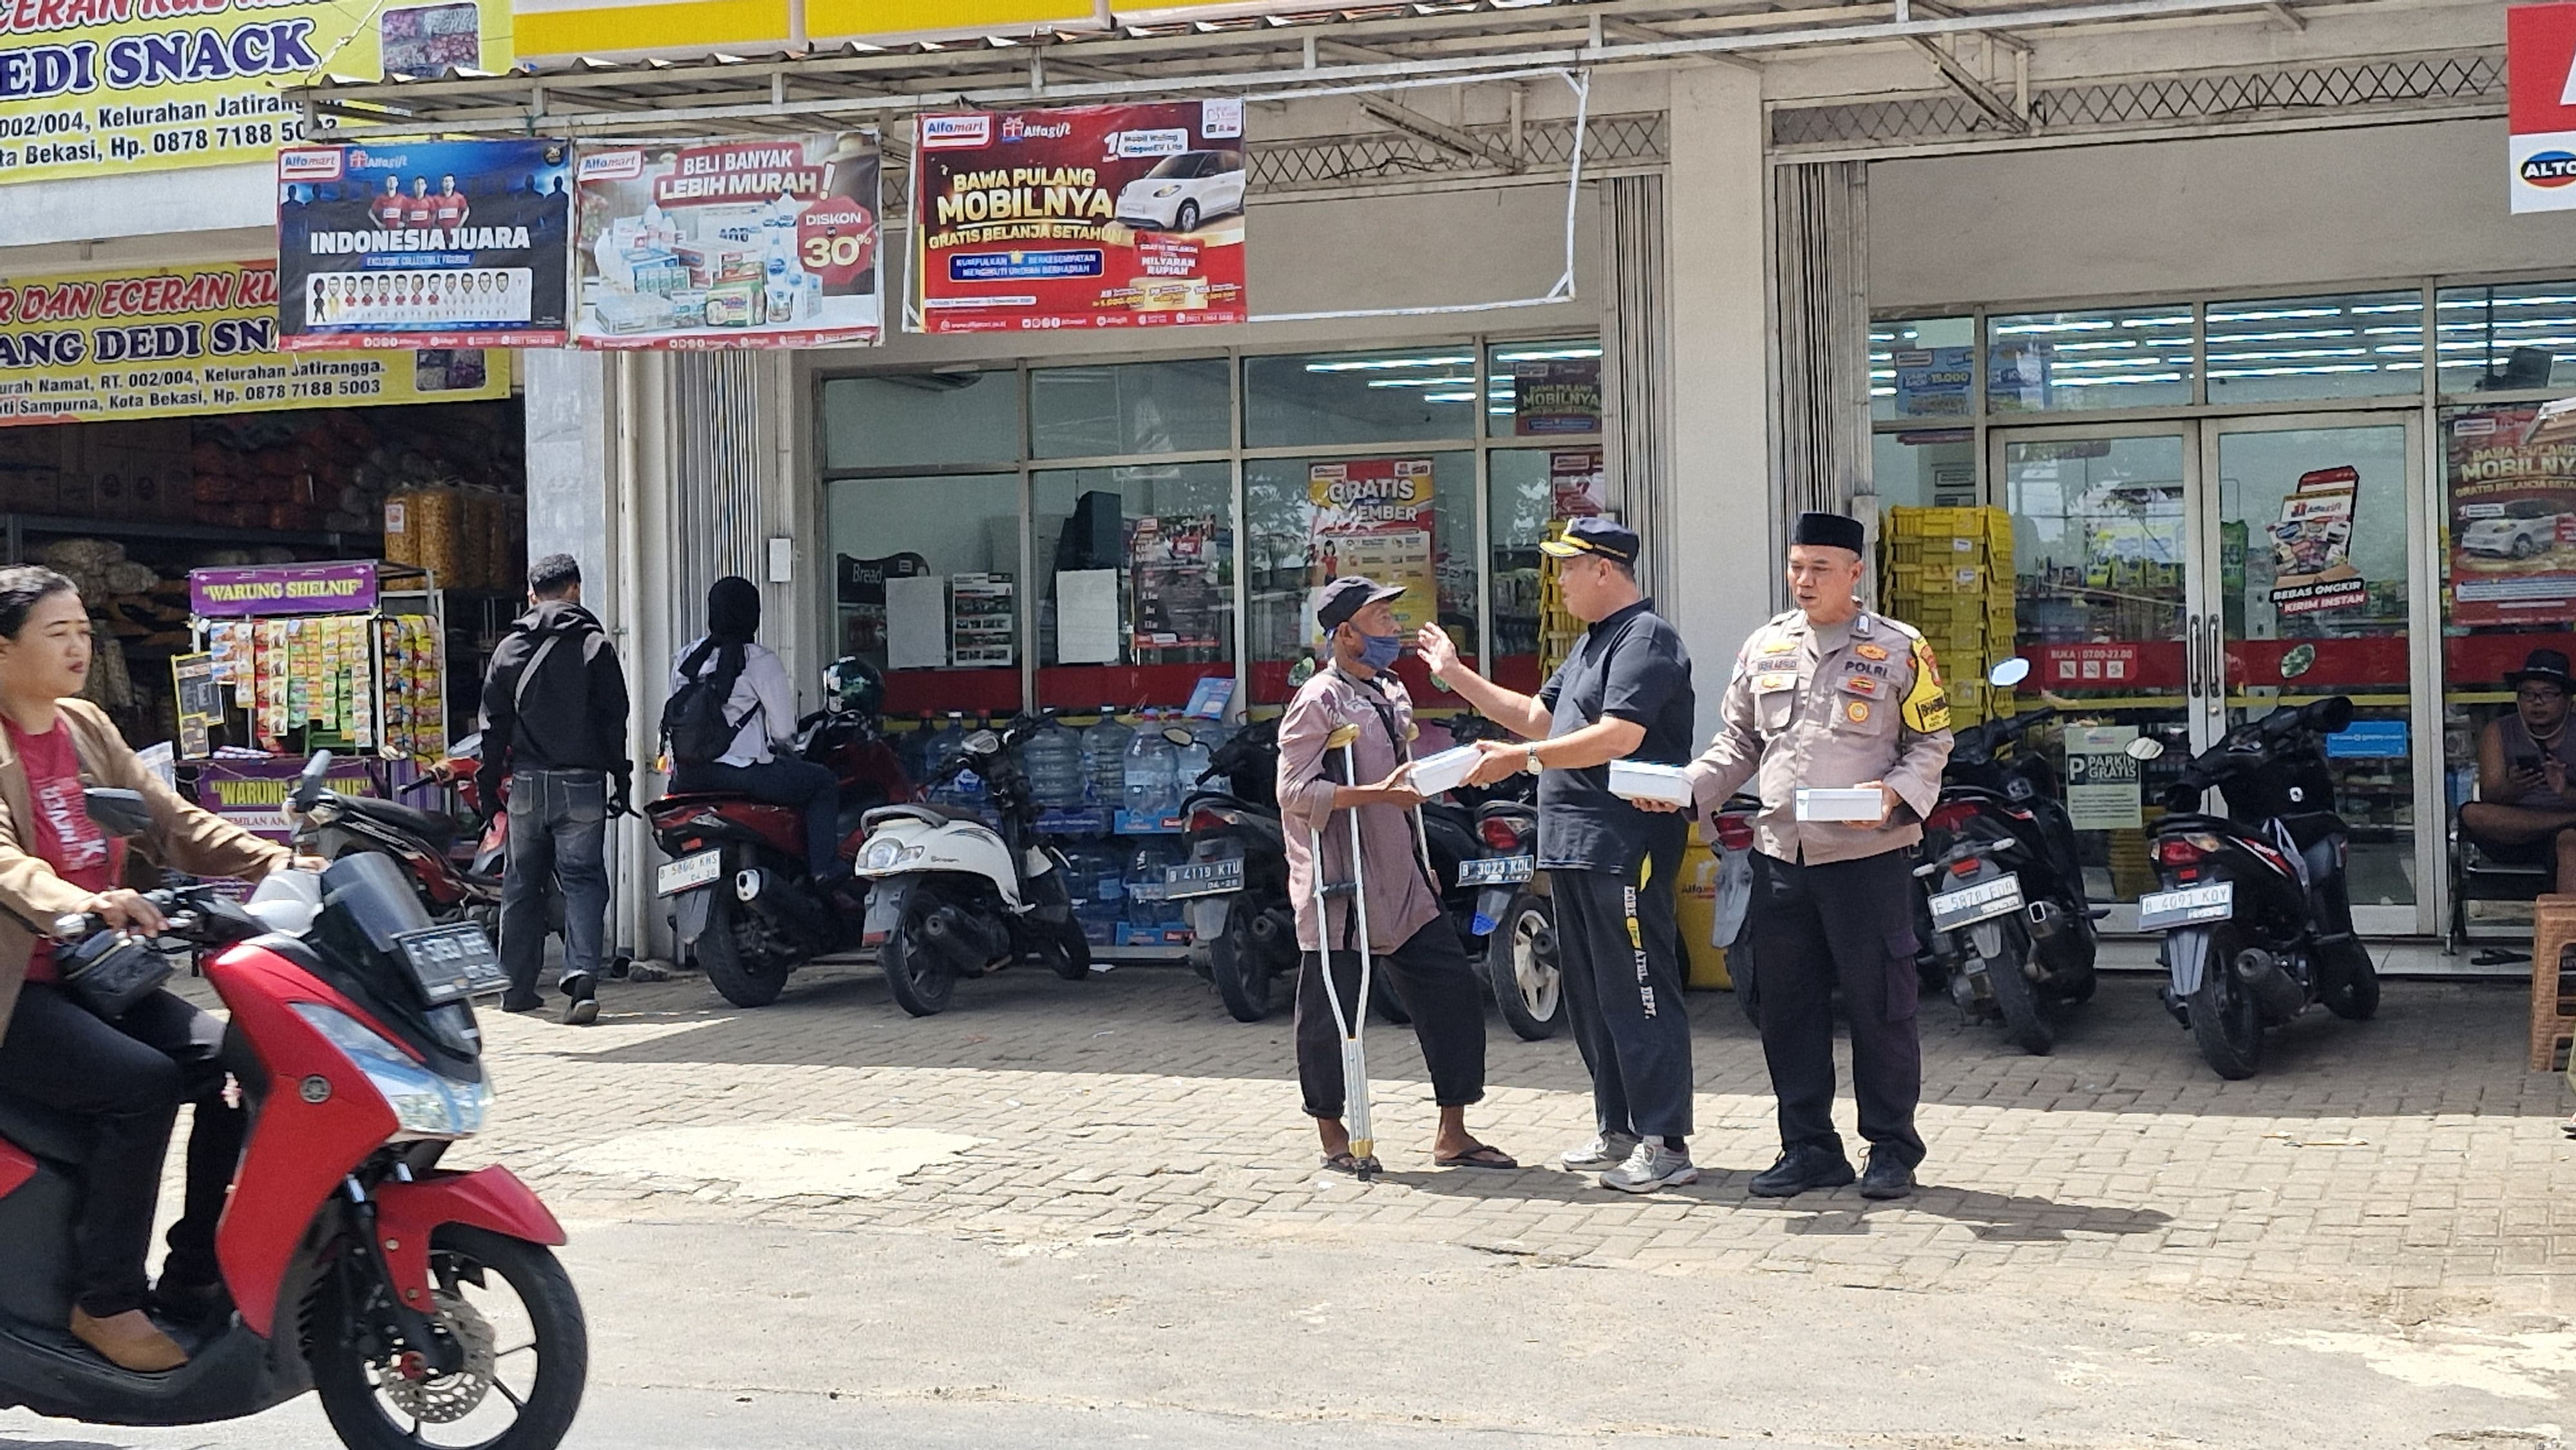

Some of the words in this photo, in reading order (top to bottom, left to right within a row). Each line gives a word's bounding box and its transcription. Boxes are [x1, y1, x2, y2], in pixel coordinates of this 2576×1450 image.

[110, 23, 314, 84] SNACK
[99, 102, 206, 128] Kelurahan
[927, 120, 984, 133] Alfamart
[1023, 122, 1071, 138] Alfagift
[26, 139, 102, 163] Bekasi,
[111, 136, 145, 160] Hp.
[154, 129, 207, 153] 0878
[217, 124, 272, 147] 7188
[285, 155, 336, 167] Alfamart
[583, 156, 636, 171] Alfamart
[683, 155, 719, 175] BELI
[724, 150, 793, 171] BANYAK
[661, 178, 724, 200] LEBIH
[954, 169, 1012, 192] BAWA
[1017, 167, 1095, 187] PULANG
[938, 189, 1113, 225] MOBILNYA
[806, 212, 861, 226] DISKON
[310, 229, 445, 254] INDONESIA
[450, 226, 531, 250] JUARA
[929, 231, 980, 249] GRATIS
[983, 227, 1050, 243] BELANJA
[1054, 225, 1121, 243] SETAHUN
[1142, 256, 1196, 268] MILYARAN
[1147, 266, 1188, 276] RUPIAH
[21, 285, 95, 320] DAN
[100, 274, 231, 314] ECERAN
[97, 325, 202, 361] DEDI
[213, 319, 278, 352] SN
[40, 377, 95, 392] Namat,
[101, 375, 123, 389] RT.
[129, 370, 200, 388] 002/004,
[205, 365, 285, 382] Kelurahan
[292, 361, 385, 377] Jatirangga.
[21, 399, 103, 415] Sampurna,
[110, 393, 143, 408] Kota
[151, 390, 207, 407] Bekasi,
[214, 388, 239, 403] Hp.
[246, 383, 285, 399] 0878
[292, 381, 332, 397] 7188
[339, 379, 380, 395] 5003
[1523, 392, 1599, 408] MOBILNYA
[1329, 478, 1415, 504] GRATIS
[853, 563, 883, 584] Bread
[2273, 587, 2313, 600] BEBAS
[2315, 581, 2362, 594] ONGKIR
[2284, 599, 2318, 612] KIRIM
[2321, 594, 2365, 607] INSTAN
[2051, 650, 2076, 659] BUKA
[1844, 661, 1888, 677] POLRI
[2088, 767, 2137, 778] GRATIS
[1218, 860, 1240, 876] KTU
[1463, 864, 1468, 876] B
[1477, 861, 1505, 876] 3023
[1640, 986, 1657, 1020] DEPT.
